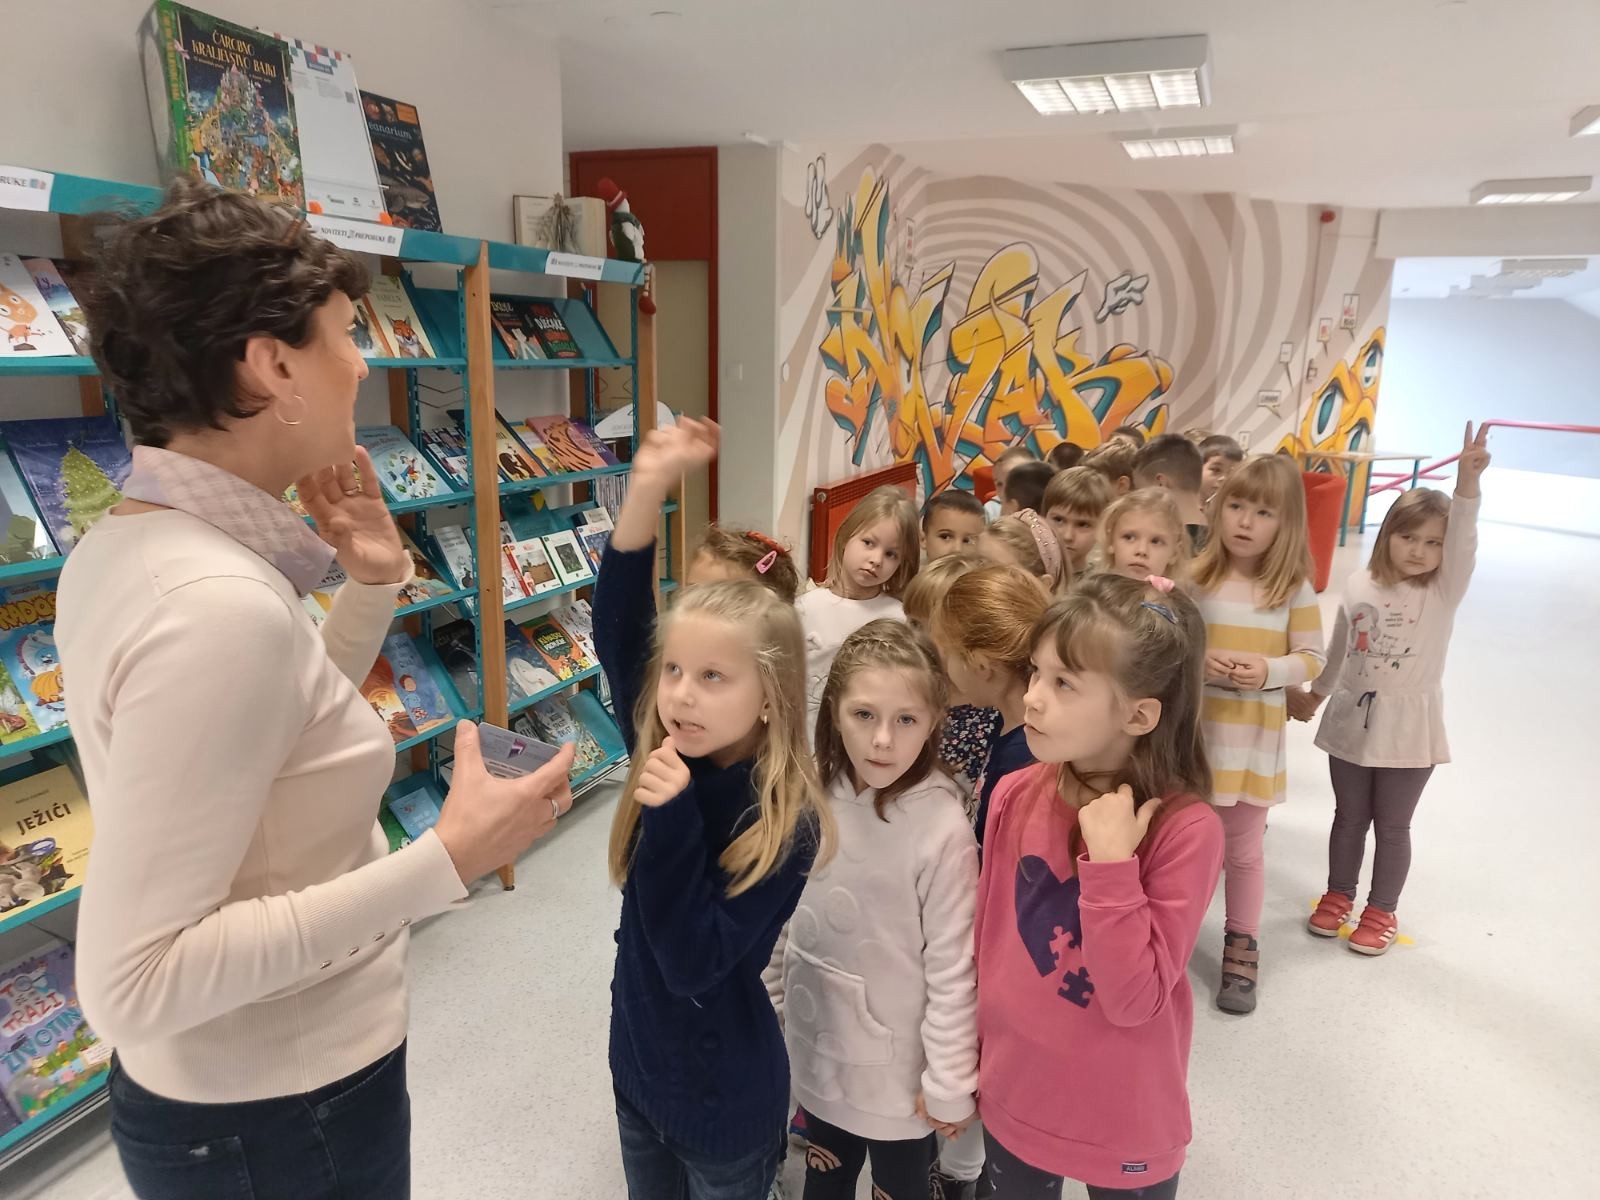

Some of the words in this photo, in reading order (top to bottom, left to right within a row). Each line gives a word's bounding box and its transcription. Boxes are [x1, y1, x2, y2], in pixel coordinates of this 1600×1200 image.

[191, 39, 251, 70] KRALJEVSTVO
[253, 59, 277, 78] BAJKI
[212, 29, 255, 57] ČAROBNO
[16, 802, 72, 836] JEŽIĆI
